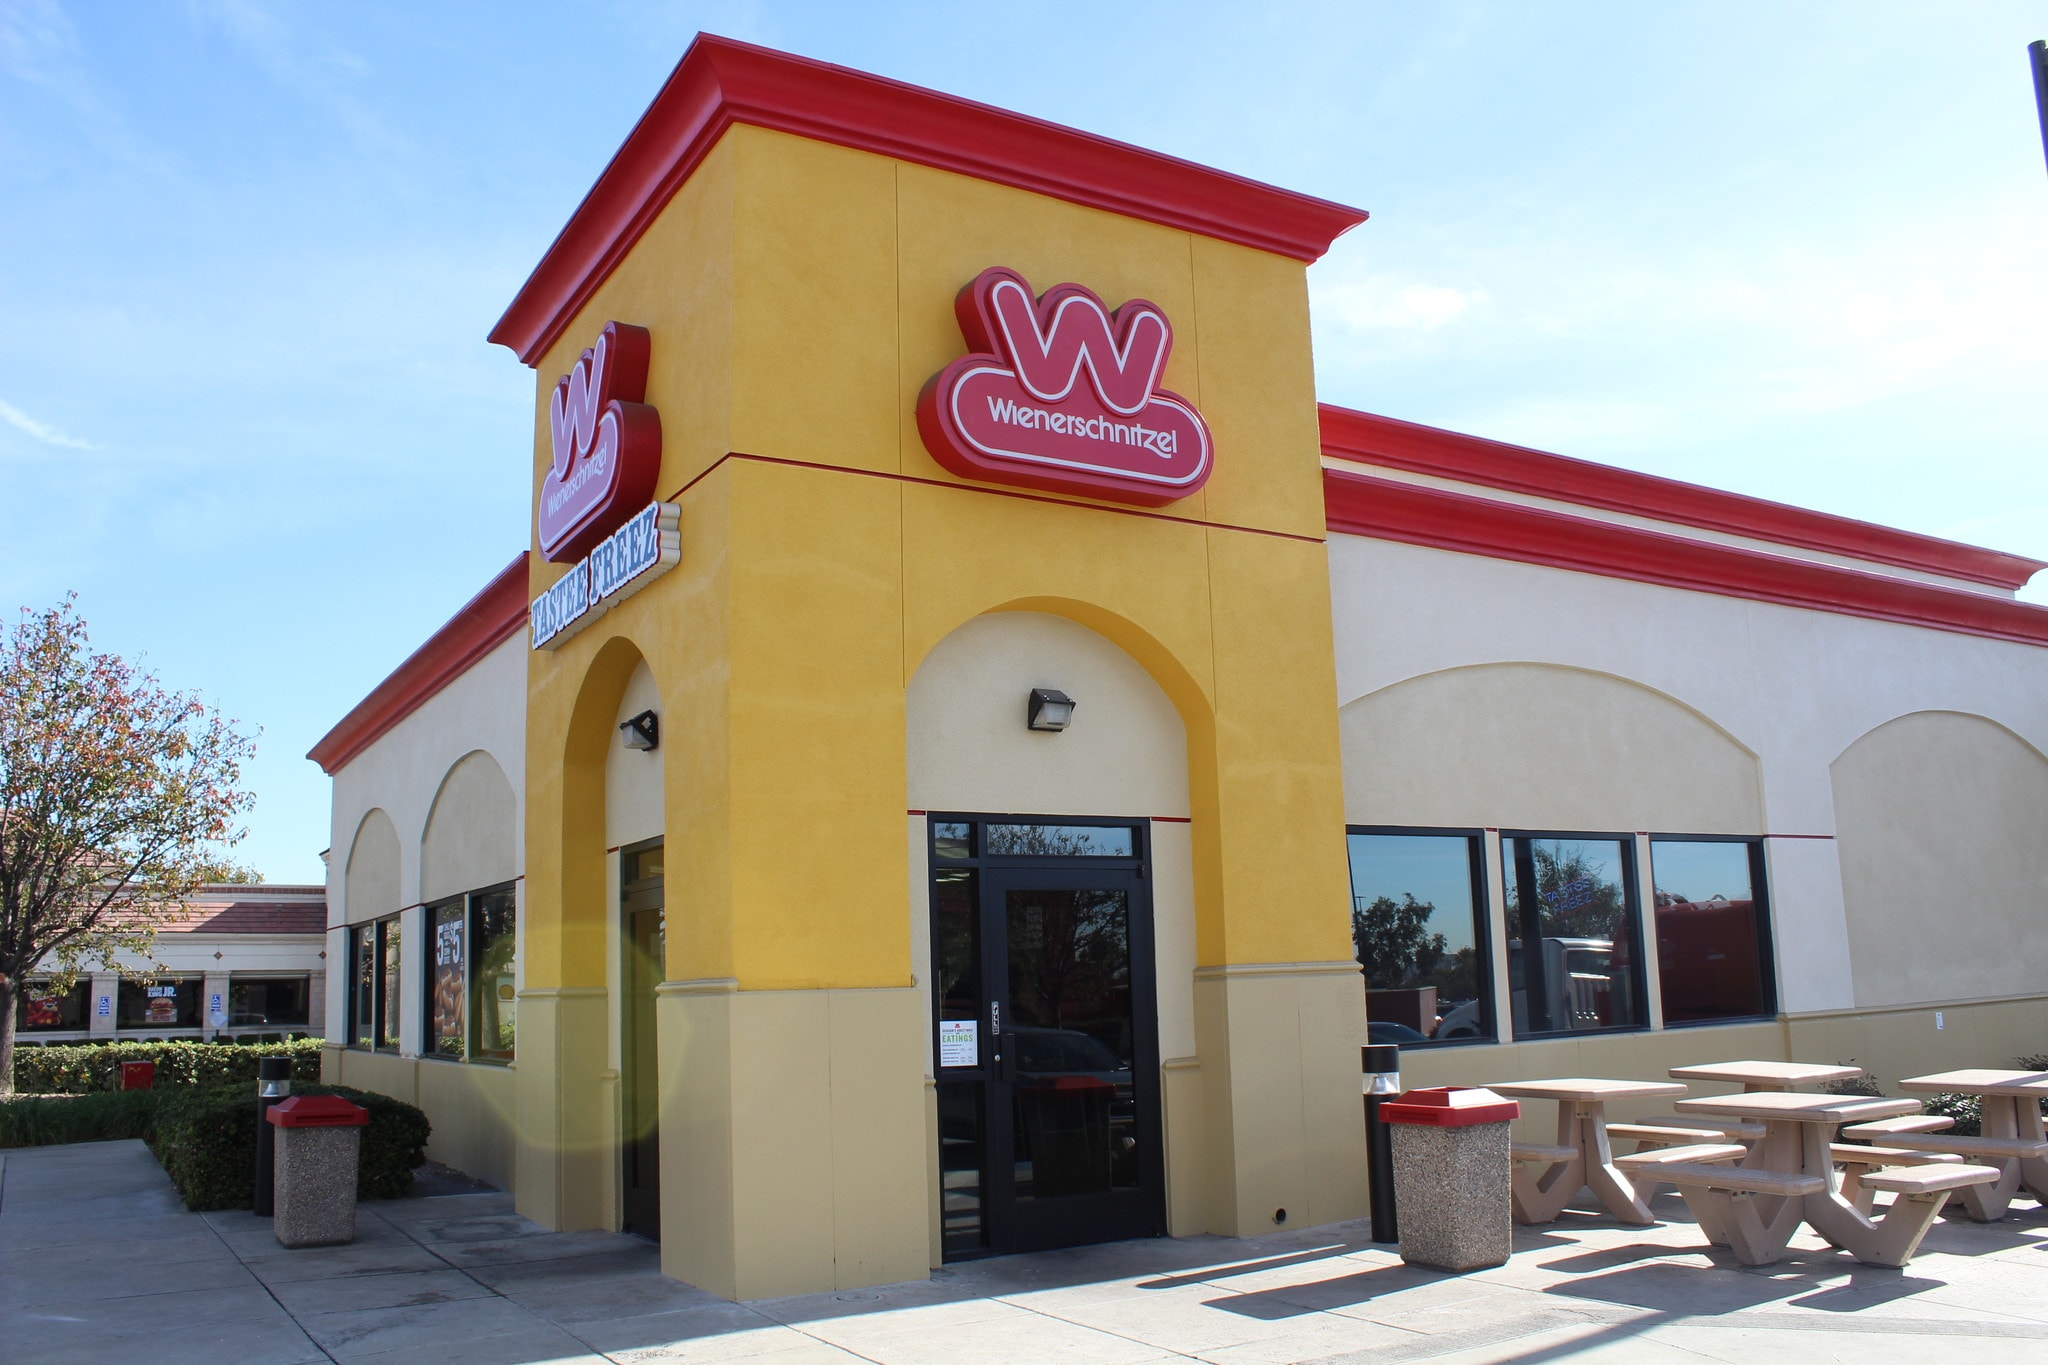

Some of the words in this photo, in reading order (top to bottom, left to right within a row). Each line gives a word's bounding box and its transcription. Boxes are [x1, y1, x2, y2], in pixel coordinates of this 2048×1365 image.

[986, 395, 1178, 459] Wienerschnitzel
[547, 441, 607, 518] Wienerschnitzel
[532, 560, 589, 645] TASTEE
[590, 505, 657, 601] FREEZ
[942, 1034, 974, 1043] EATINGS
